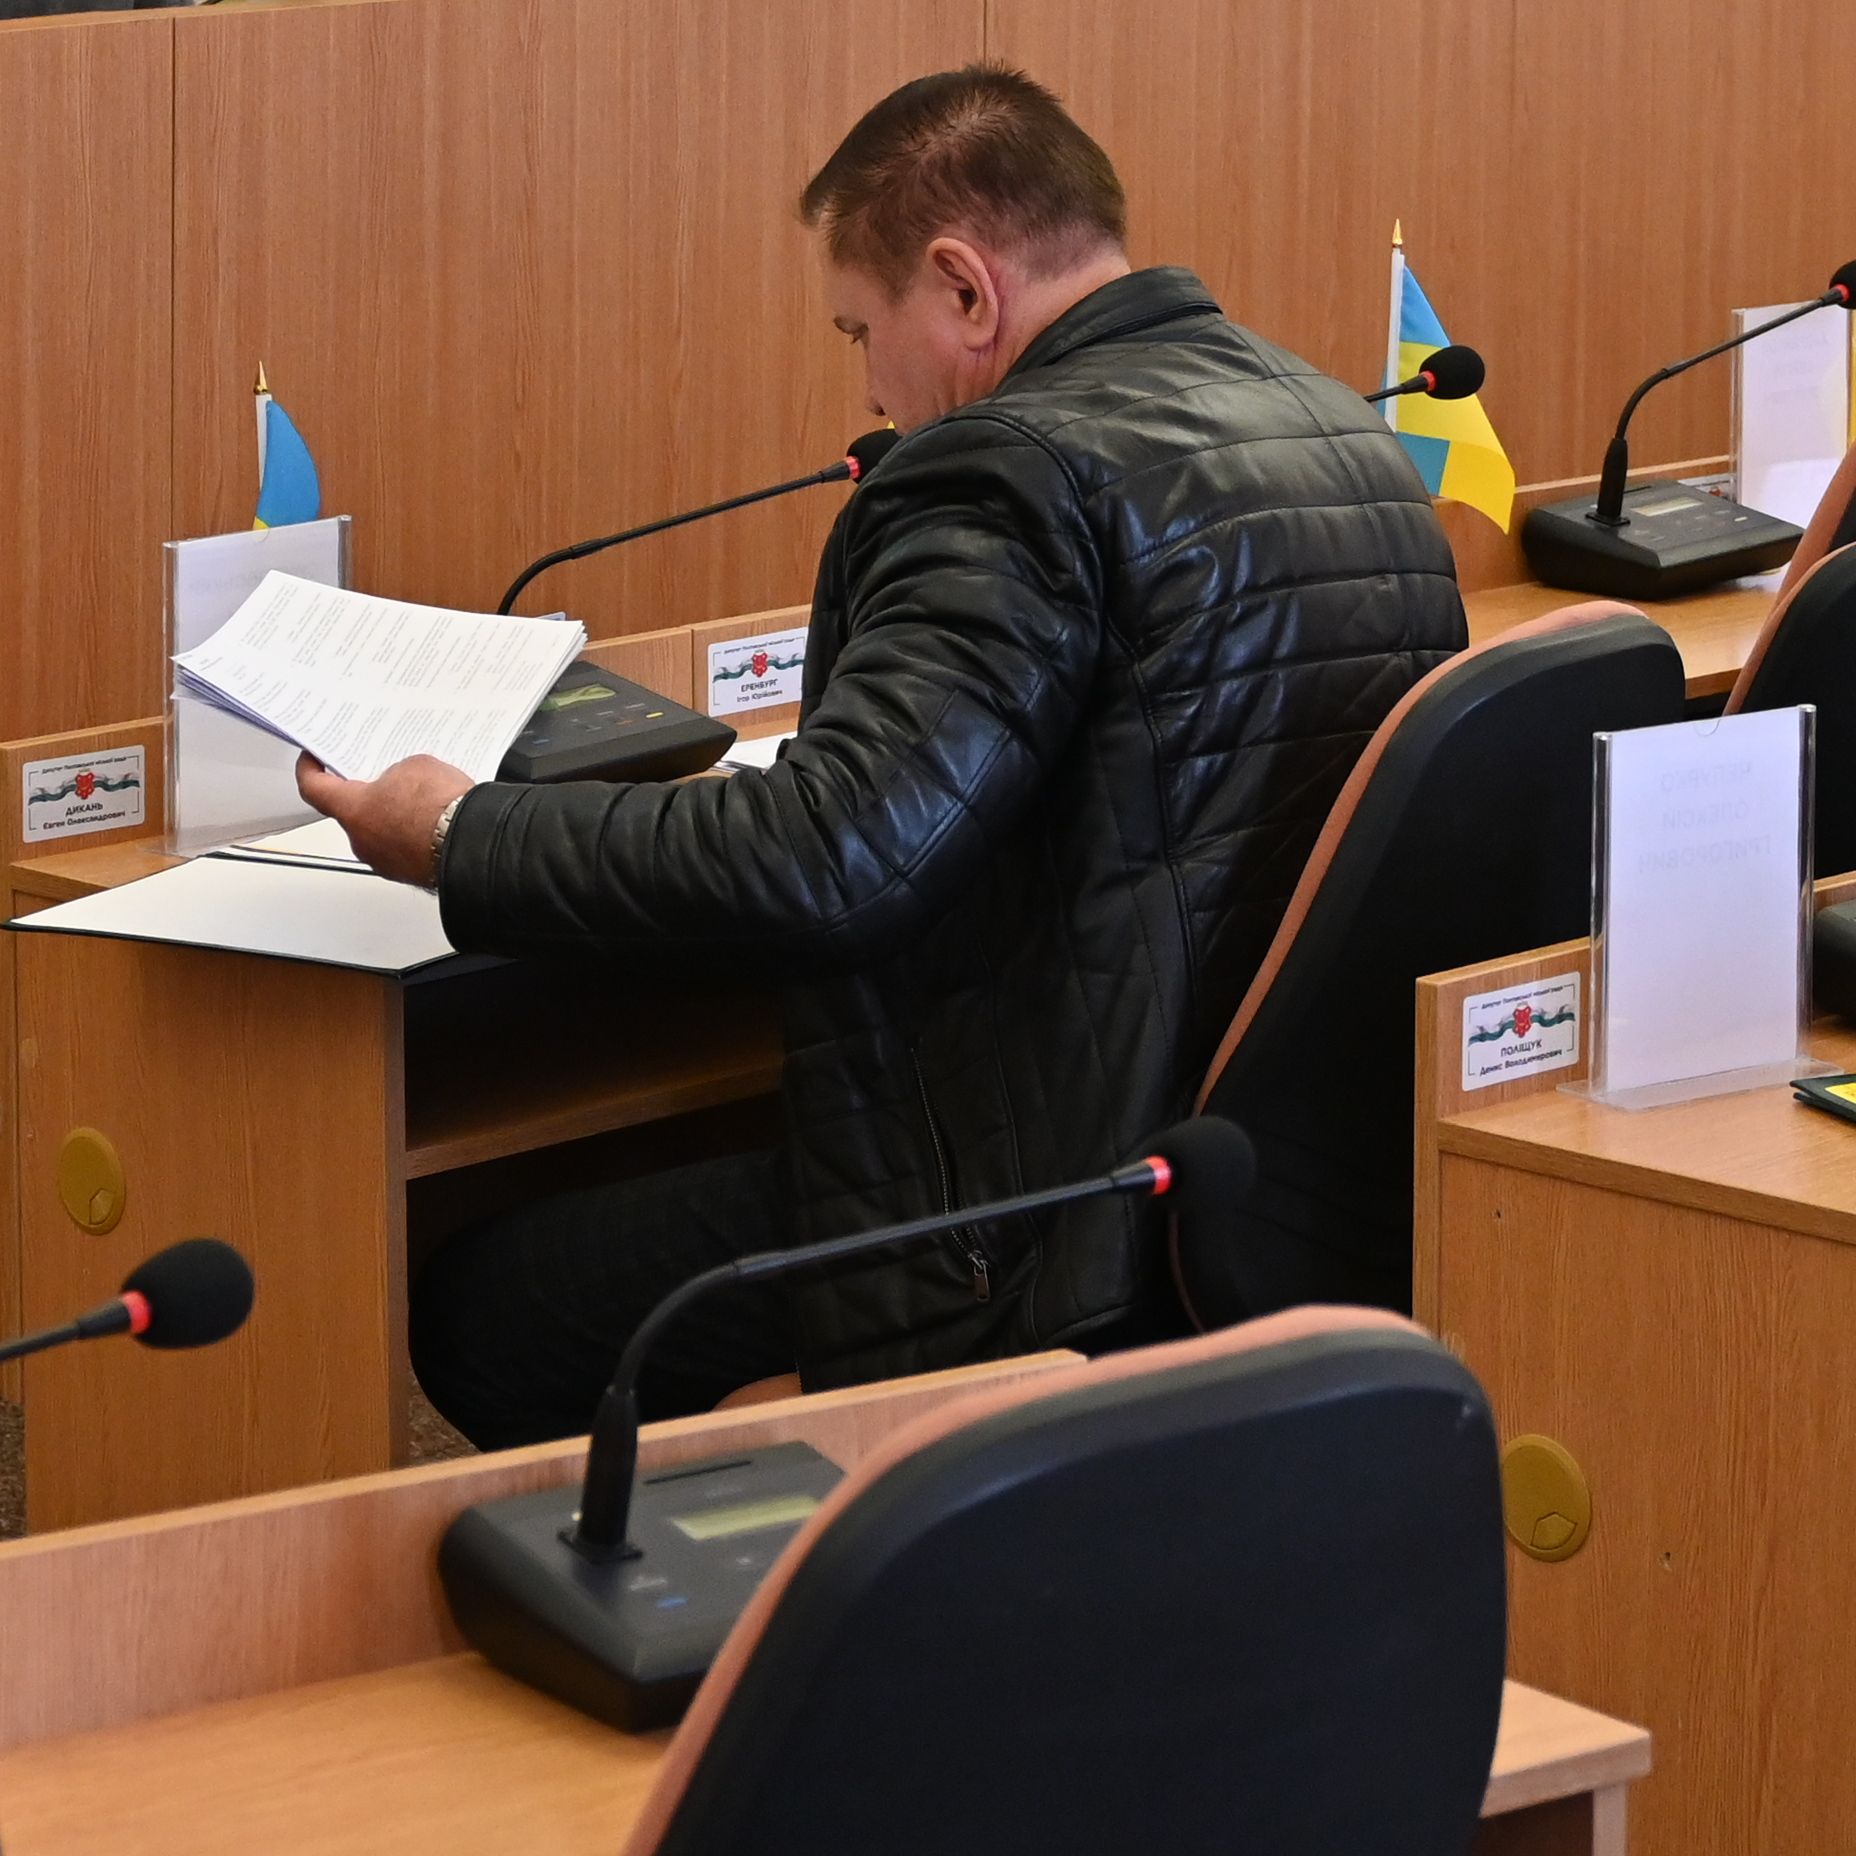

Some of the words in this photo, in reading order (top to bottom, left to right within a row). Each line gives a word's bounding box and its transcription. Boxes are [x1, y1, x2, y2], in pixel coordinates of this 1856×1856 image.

[741, 678, 778, 692] ЕРЕНБУРГ
[65, 802, 103, 817] ДИКАНЬ
[67, 811, 126, 826] Олександрович
[1500, 1039, 1542, 1057] ПОЛІЩУК
[1479, 1063, 1503, 1077] Денис
[1505, 1049, 1563, 1069] Володимирович
